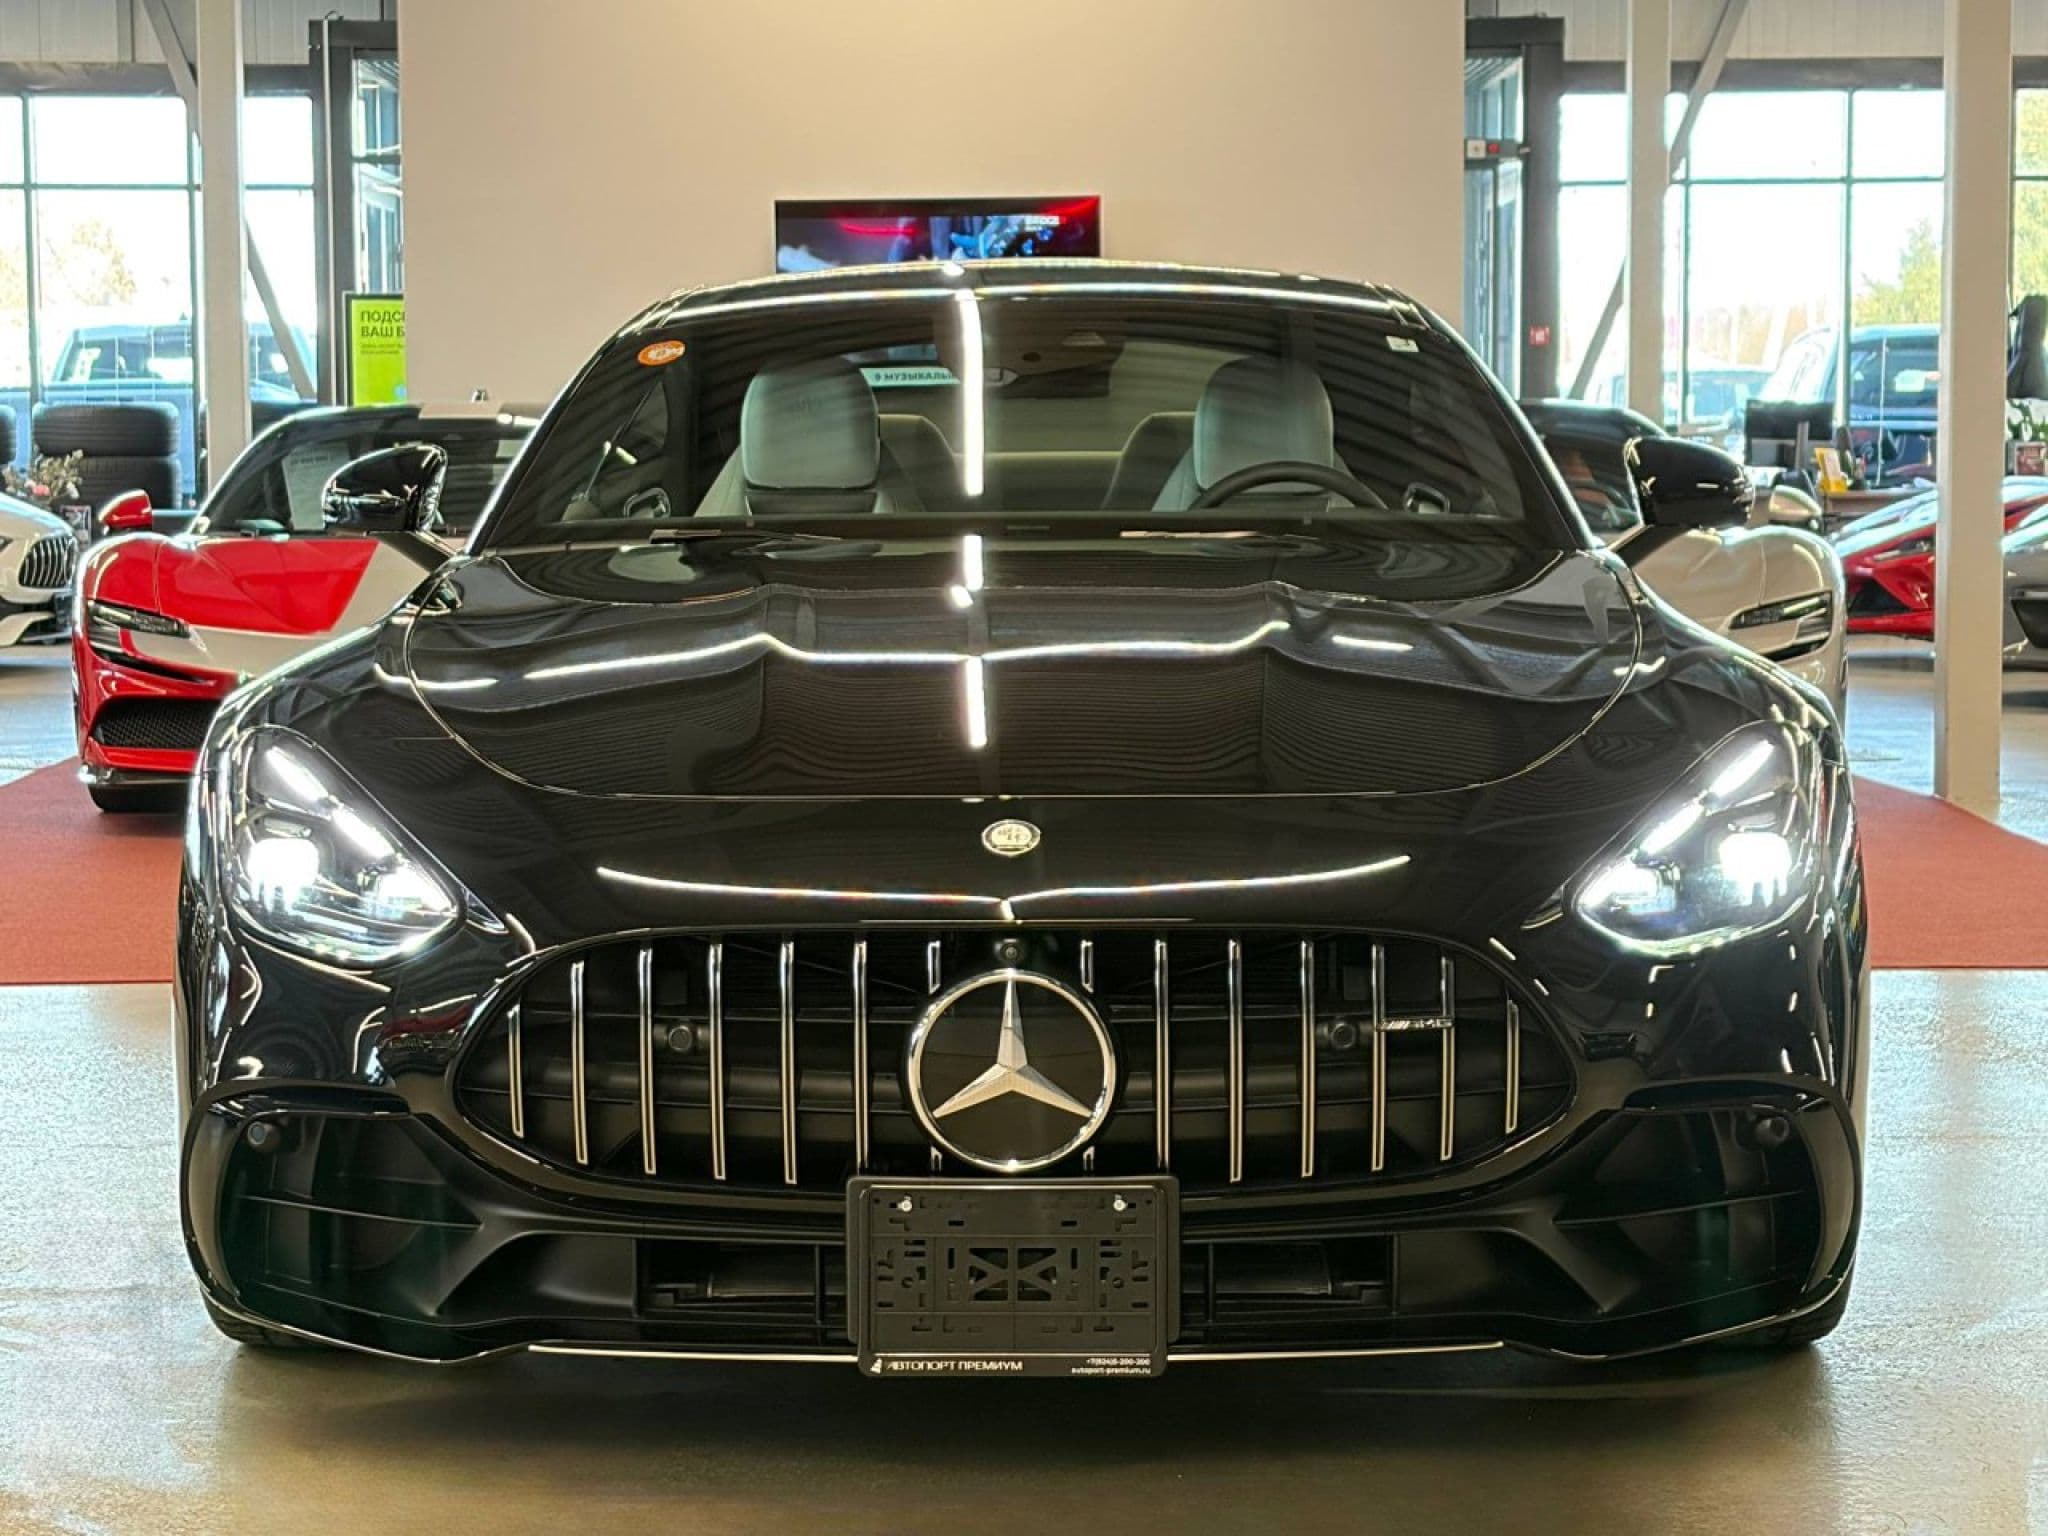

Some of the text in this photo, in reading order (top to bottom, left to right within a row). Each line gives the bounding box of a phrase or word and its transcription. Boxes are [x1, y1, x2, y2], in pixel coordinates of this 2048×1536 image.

[361, 326, 393, 337] ВАШ
[886, 1360, 1023, 1371] АВТОПОРТ ПРЕМИУМ
